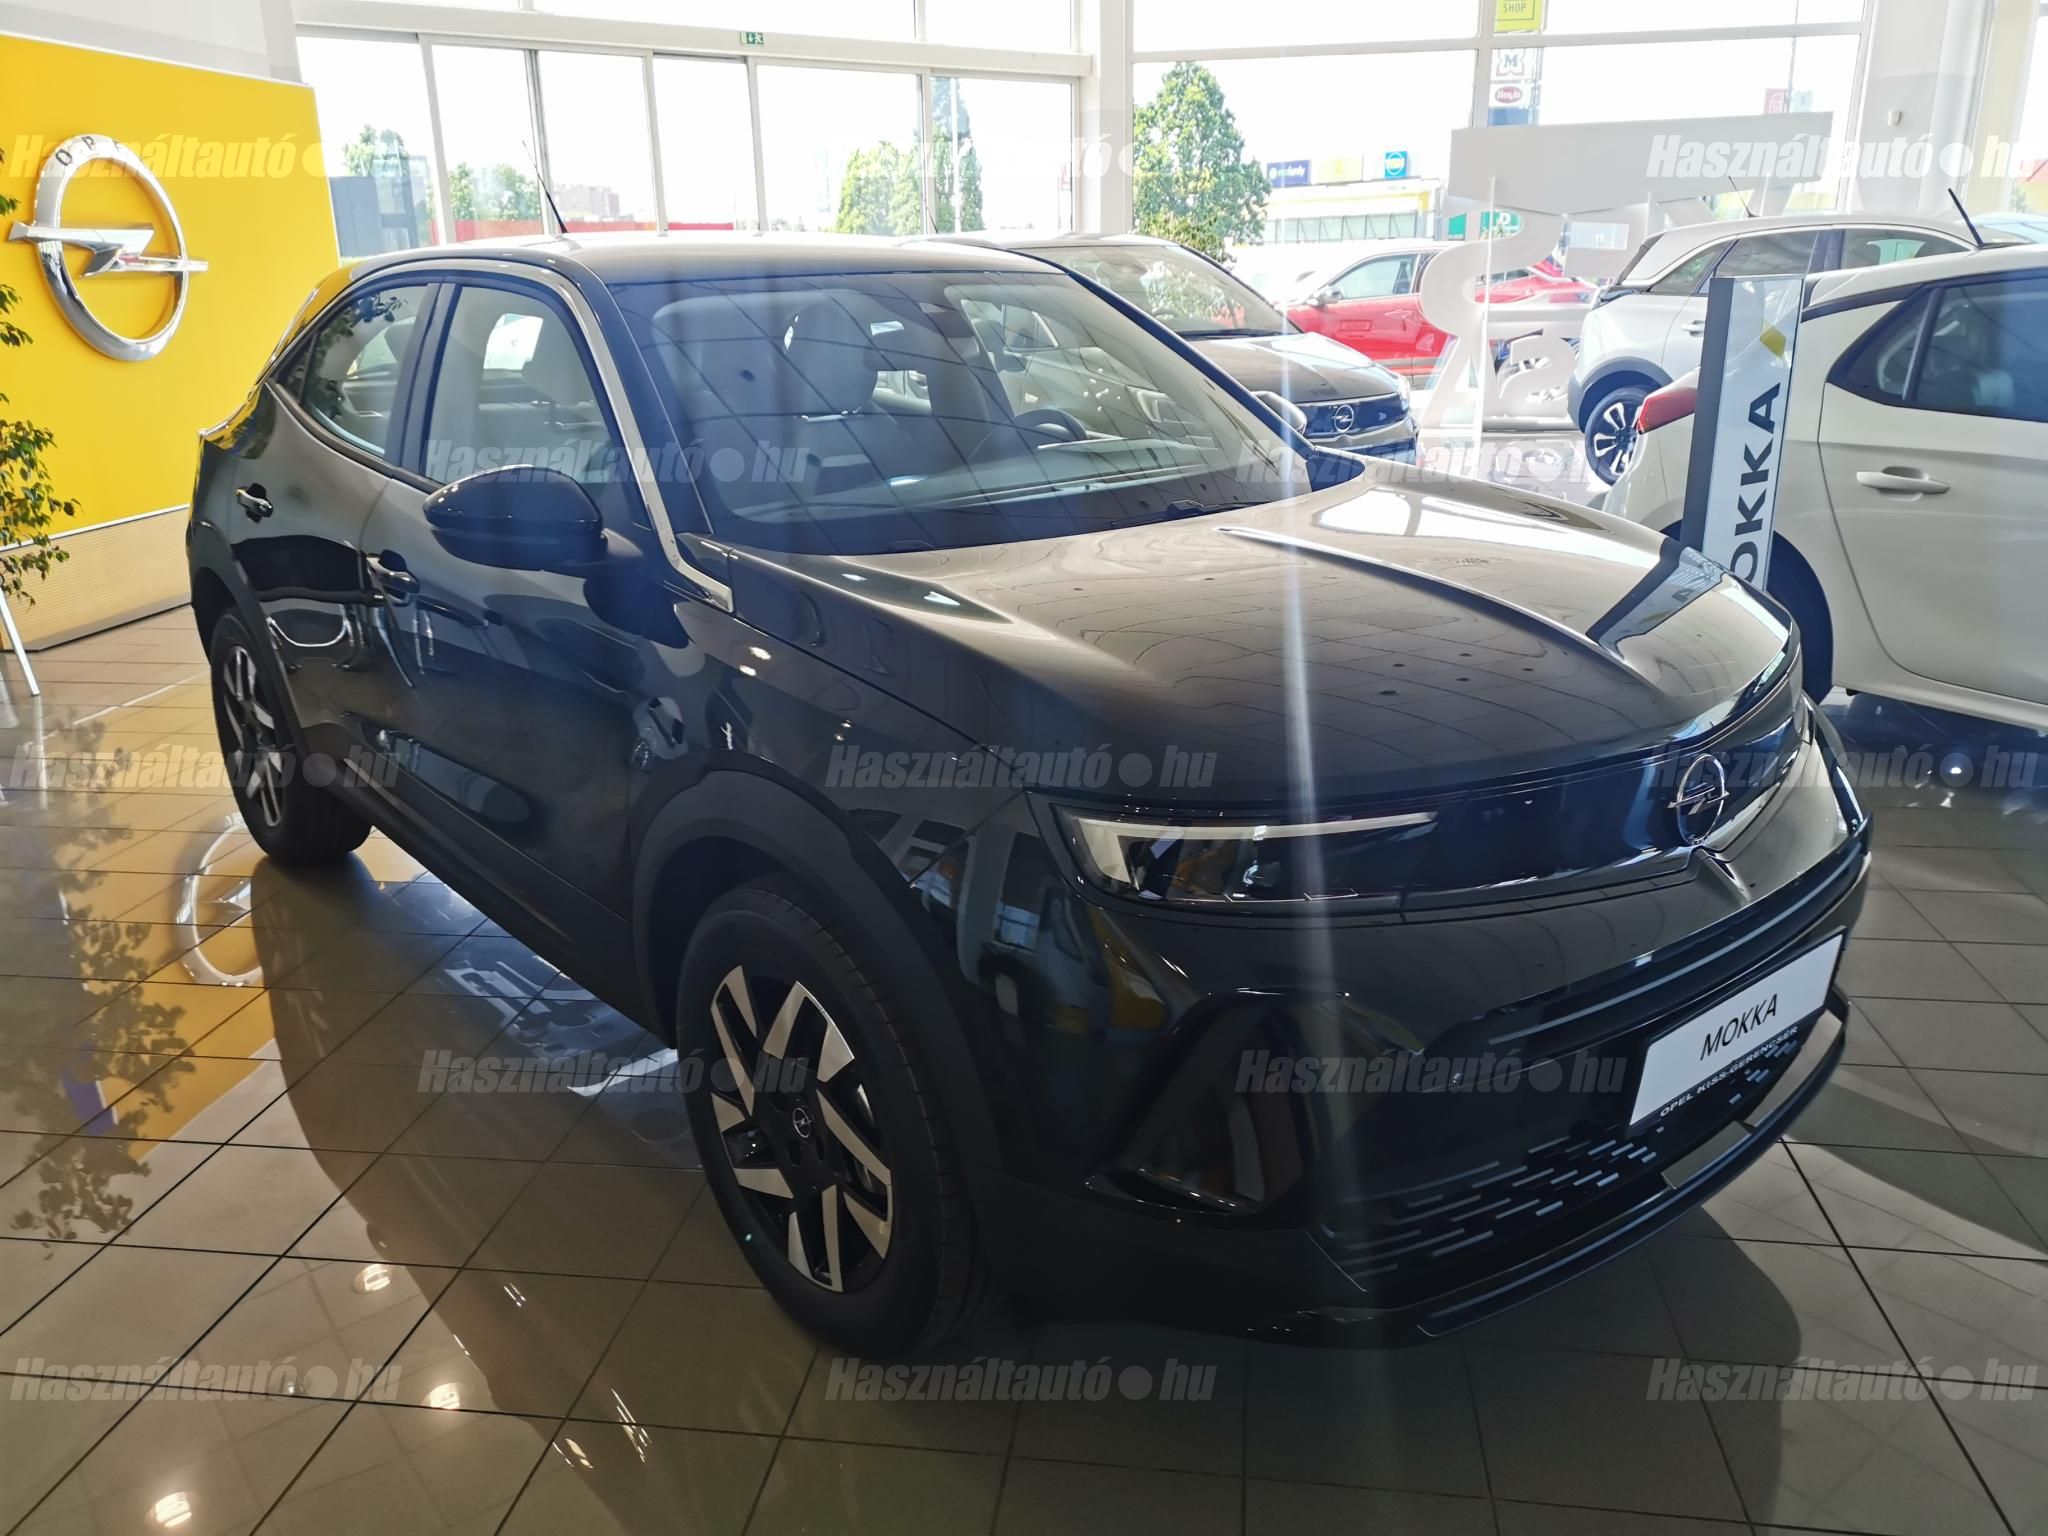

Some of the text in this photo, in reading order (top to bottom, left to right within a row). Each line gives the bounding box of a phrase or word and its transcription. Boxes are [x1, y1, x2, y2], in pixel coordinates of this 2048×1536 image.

[1503, 2, 1527, 13] SHOP
[1730, 382, 1781, 584] OKKA
[1699, 993, 1778, 1062] MOKKA
[1659, 1092, 1695, 1118] OPEL
